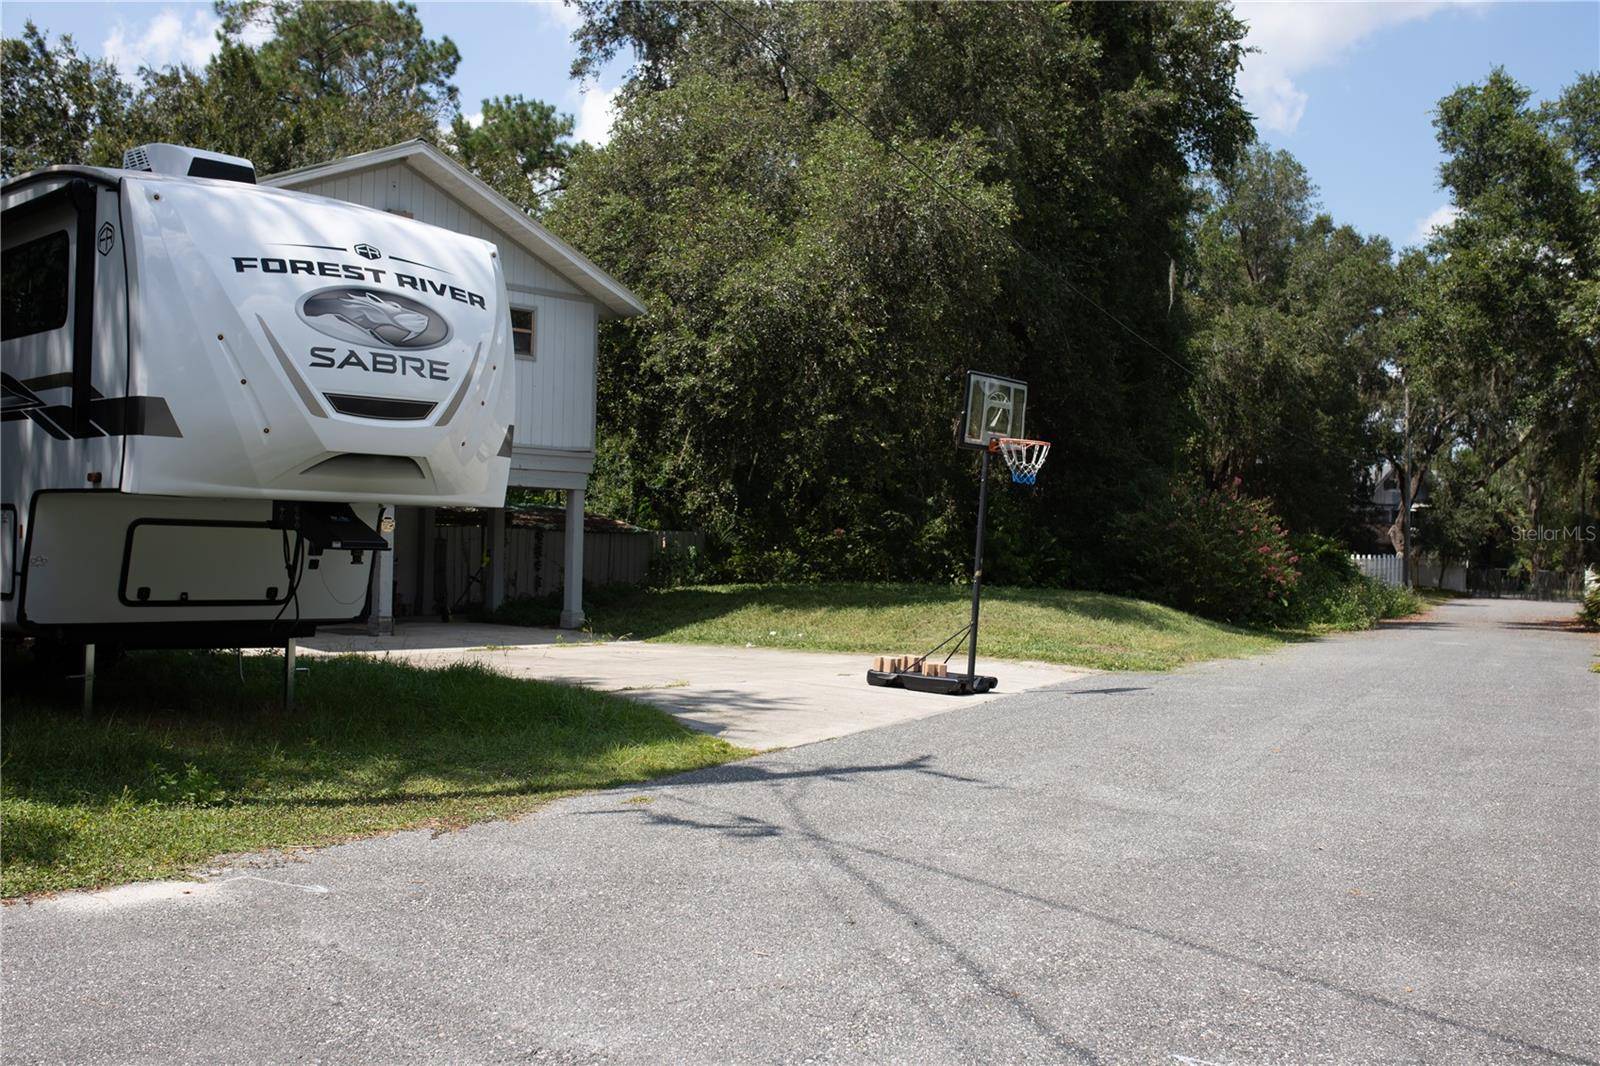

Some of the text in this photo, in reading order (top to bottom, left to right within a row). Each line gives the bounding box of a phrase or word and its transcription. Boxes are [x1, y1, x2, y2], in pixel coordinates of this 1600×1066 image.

[232, 256, 487, 310] FOREST RIVER
[309, 346, 450, 382] SABRE
